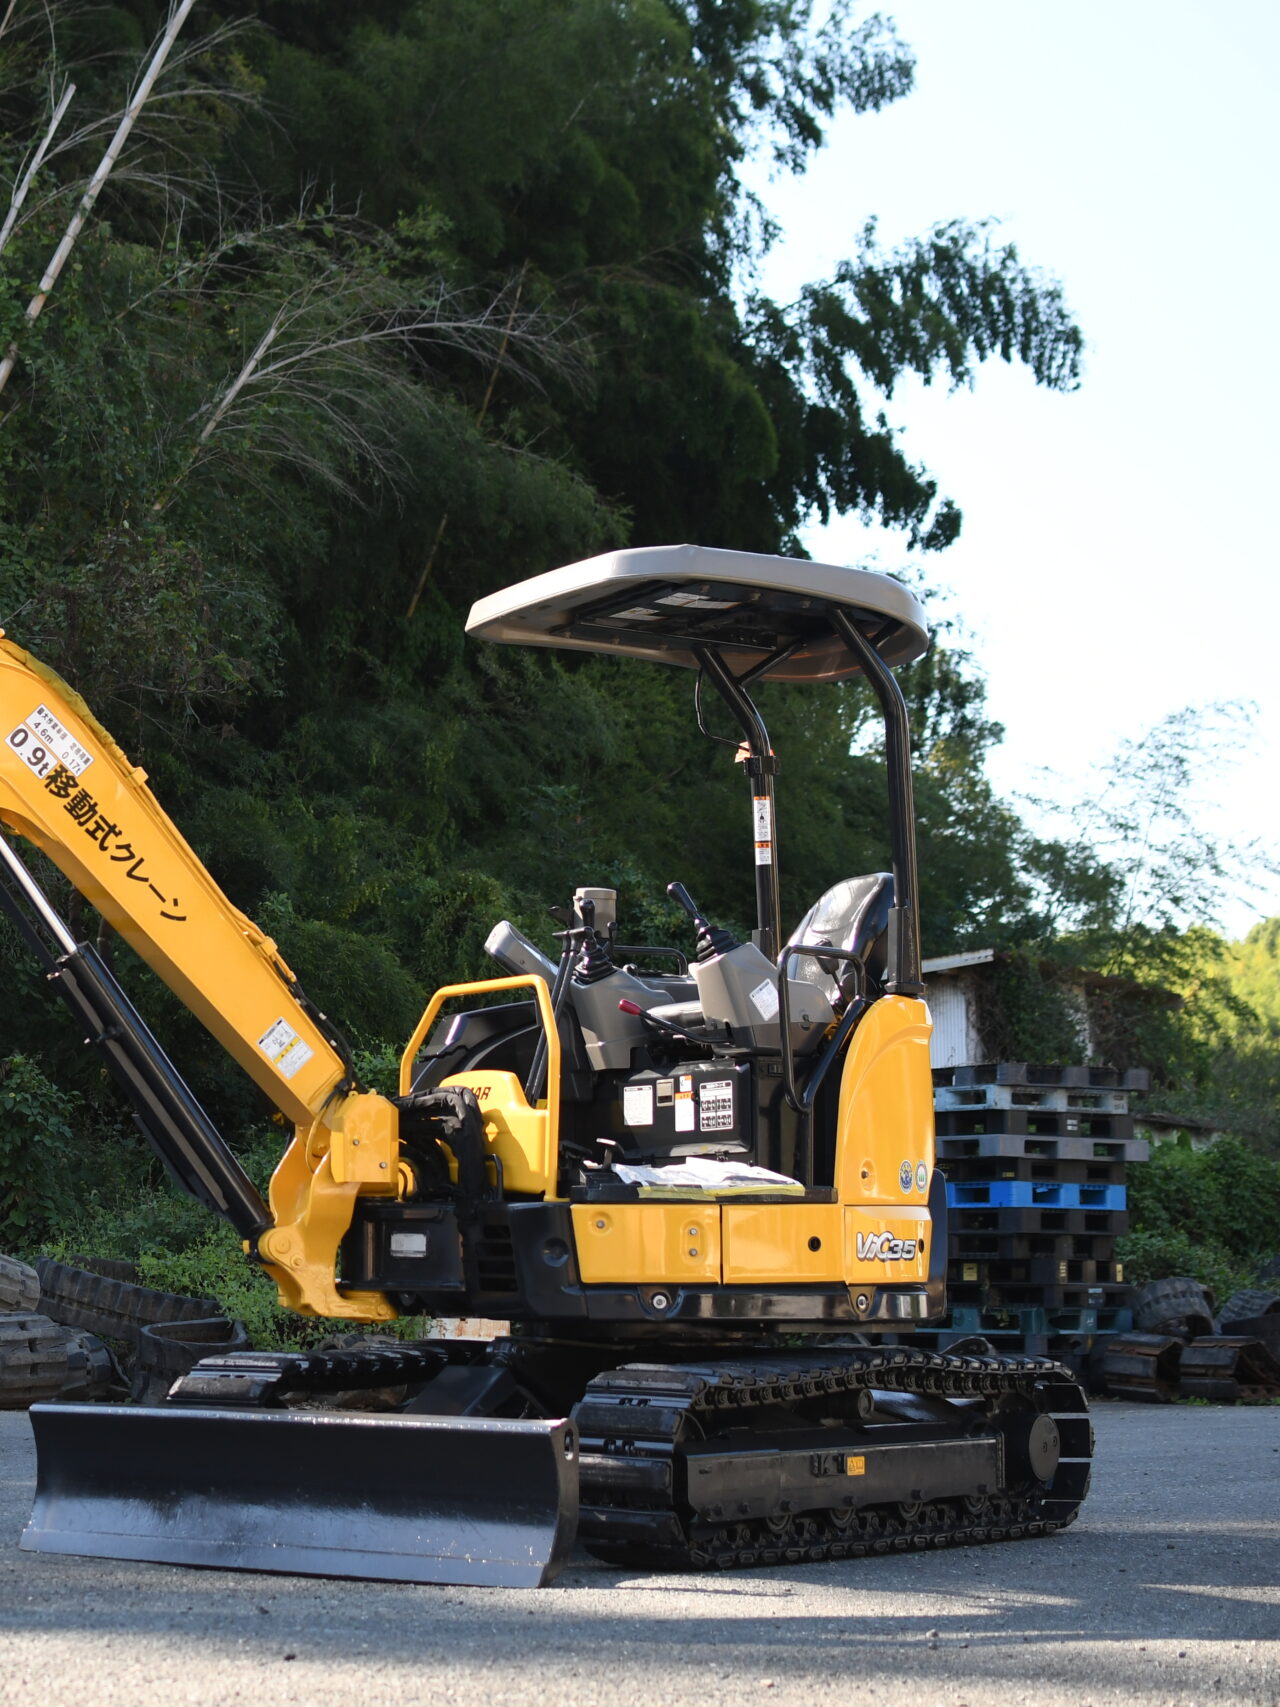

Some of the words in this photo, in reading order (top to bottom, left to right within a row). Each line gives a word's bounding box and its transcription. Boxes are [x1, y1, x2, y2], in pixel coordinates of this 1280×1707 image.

[9, 727, 50, 777] 0.9t
[33, 721, 54, 744] 4.6m
[44, 764, 187, 922] 移動式クレーン
